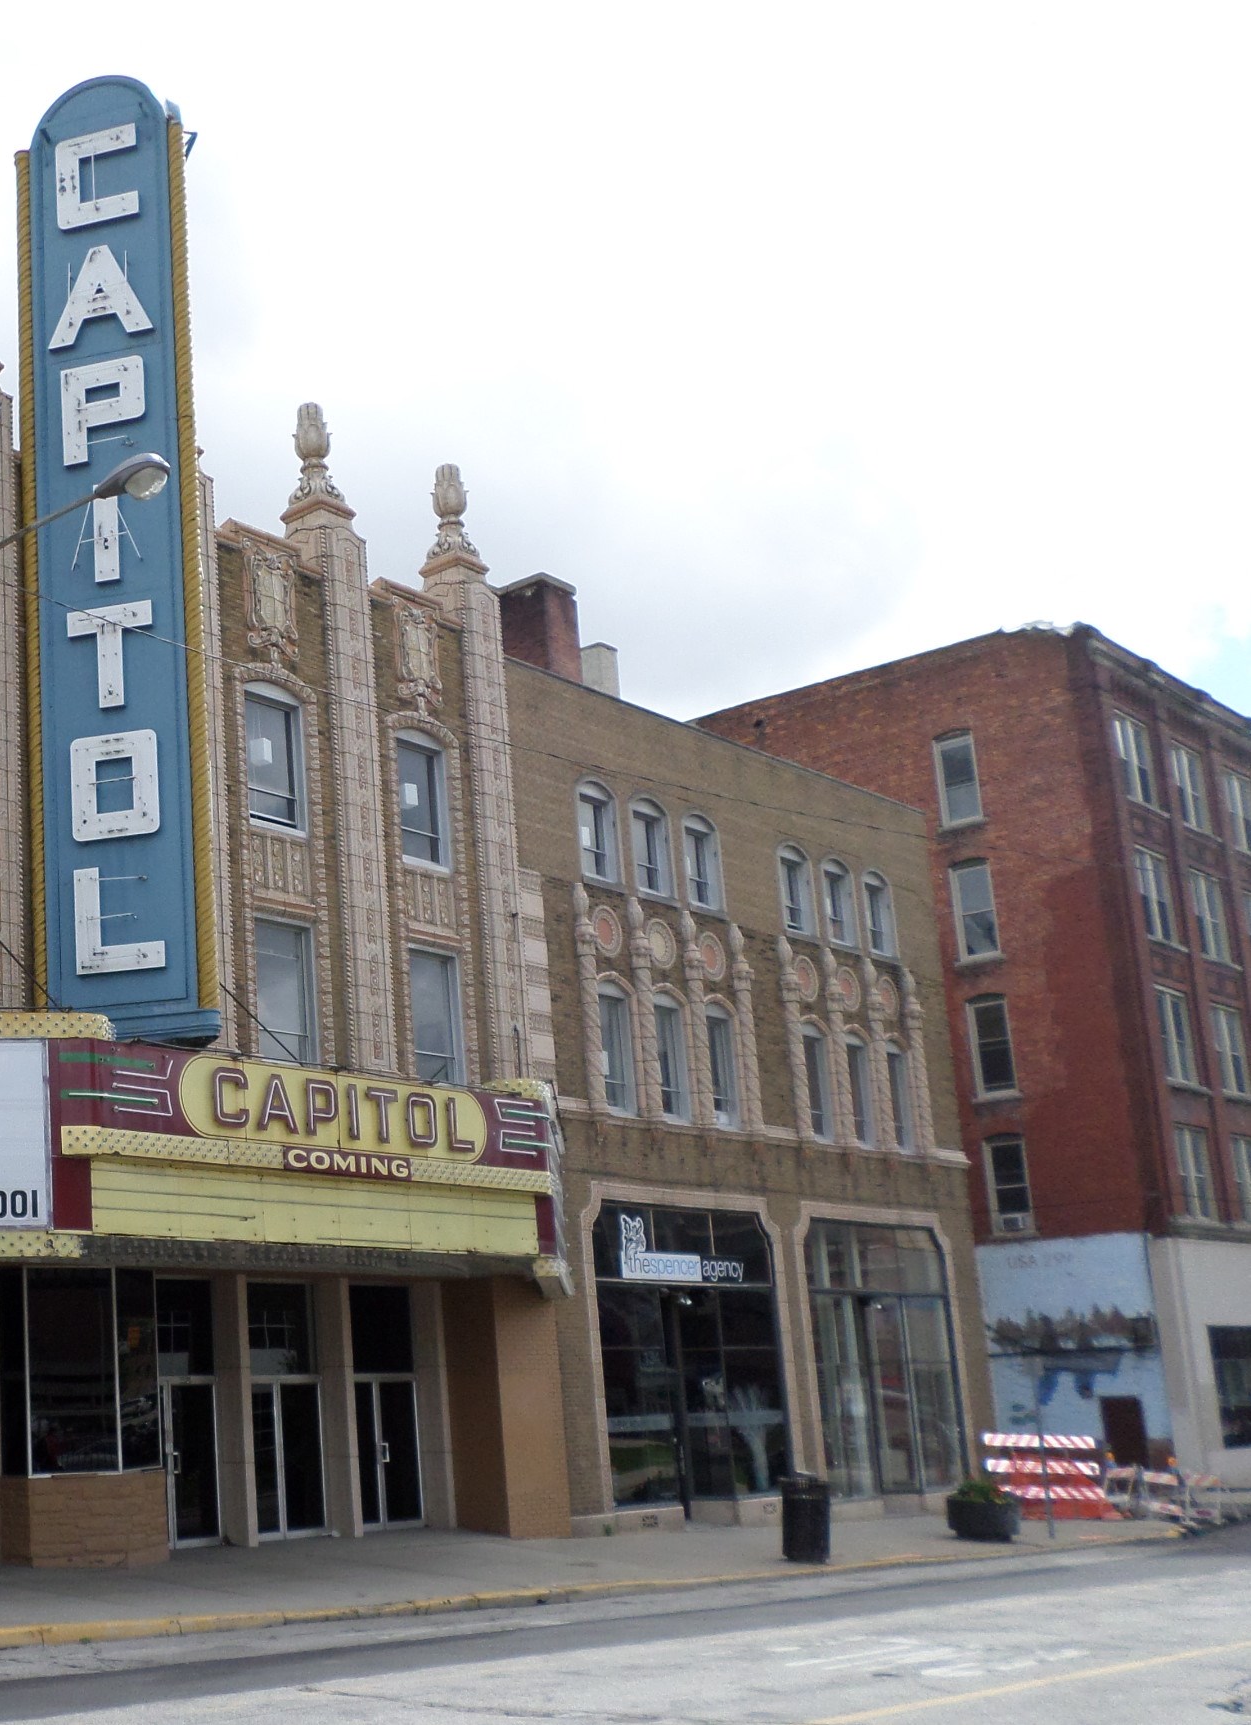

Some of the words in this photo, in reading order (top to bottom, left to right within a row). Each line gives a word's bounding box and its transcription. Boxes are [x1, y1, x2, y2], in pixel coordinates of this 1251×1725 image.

[48, 122, 166, 976] CAPITOL
[211, 1066, 476, 1153] CAPITOL
[286, 1149, 411, 1178] COMING
[702, 1259, 744, 1282] agency
